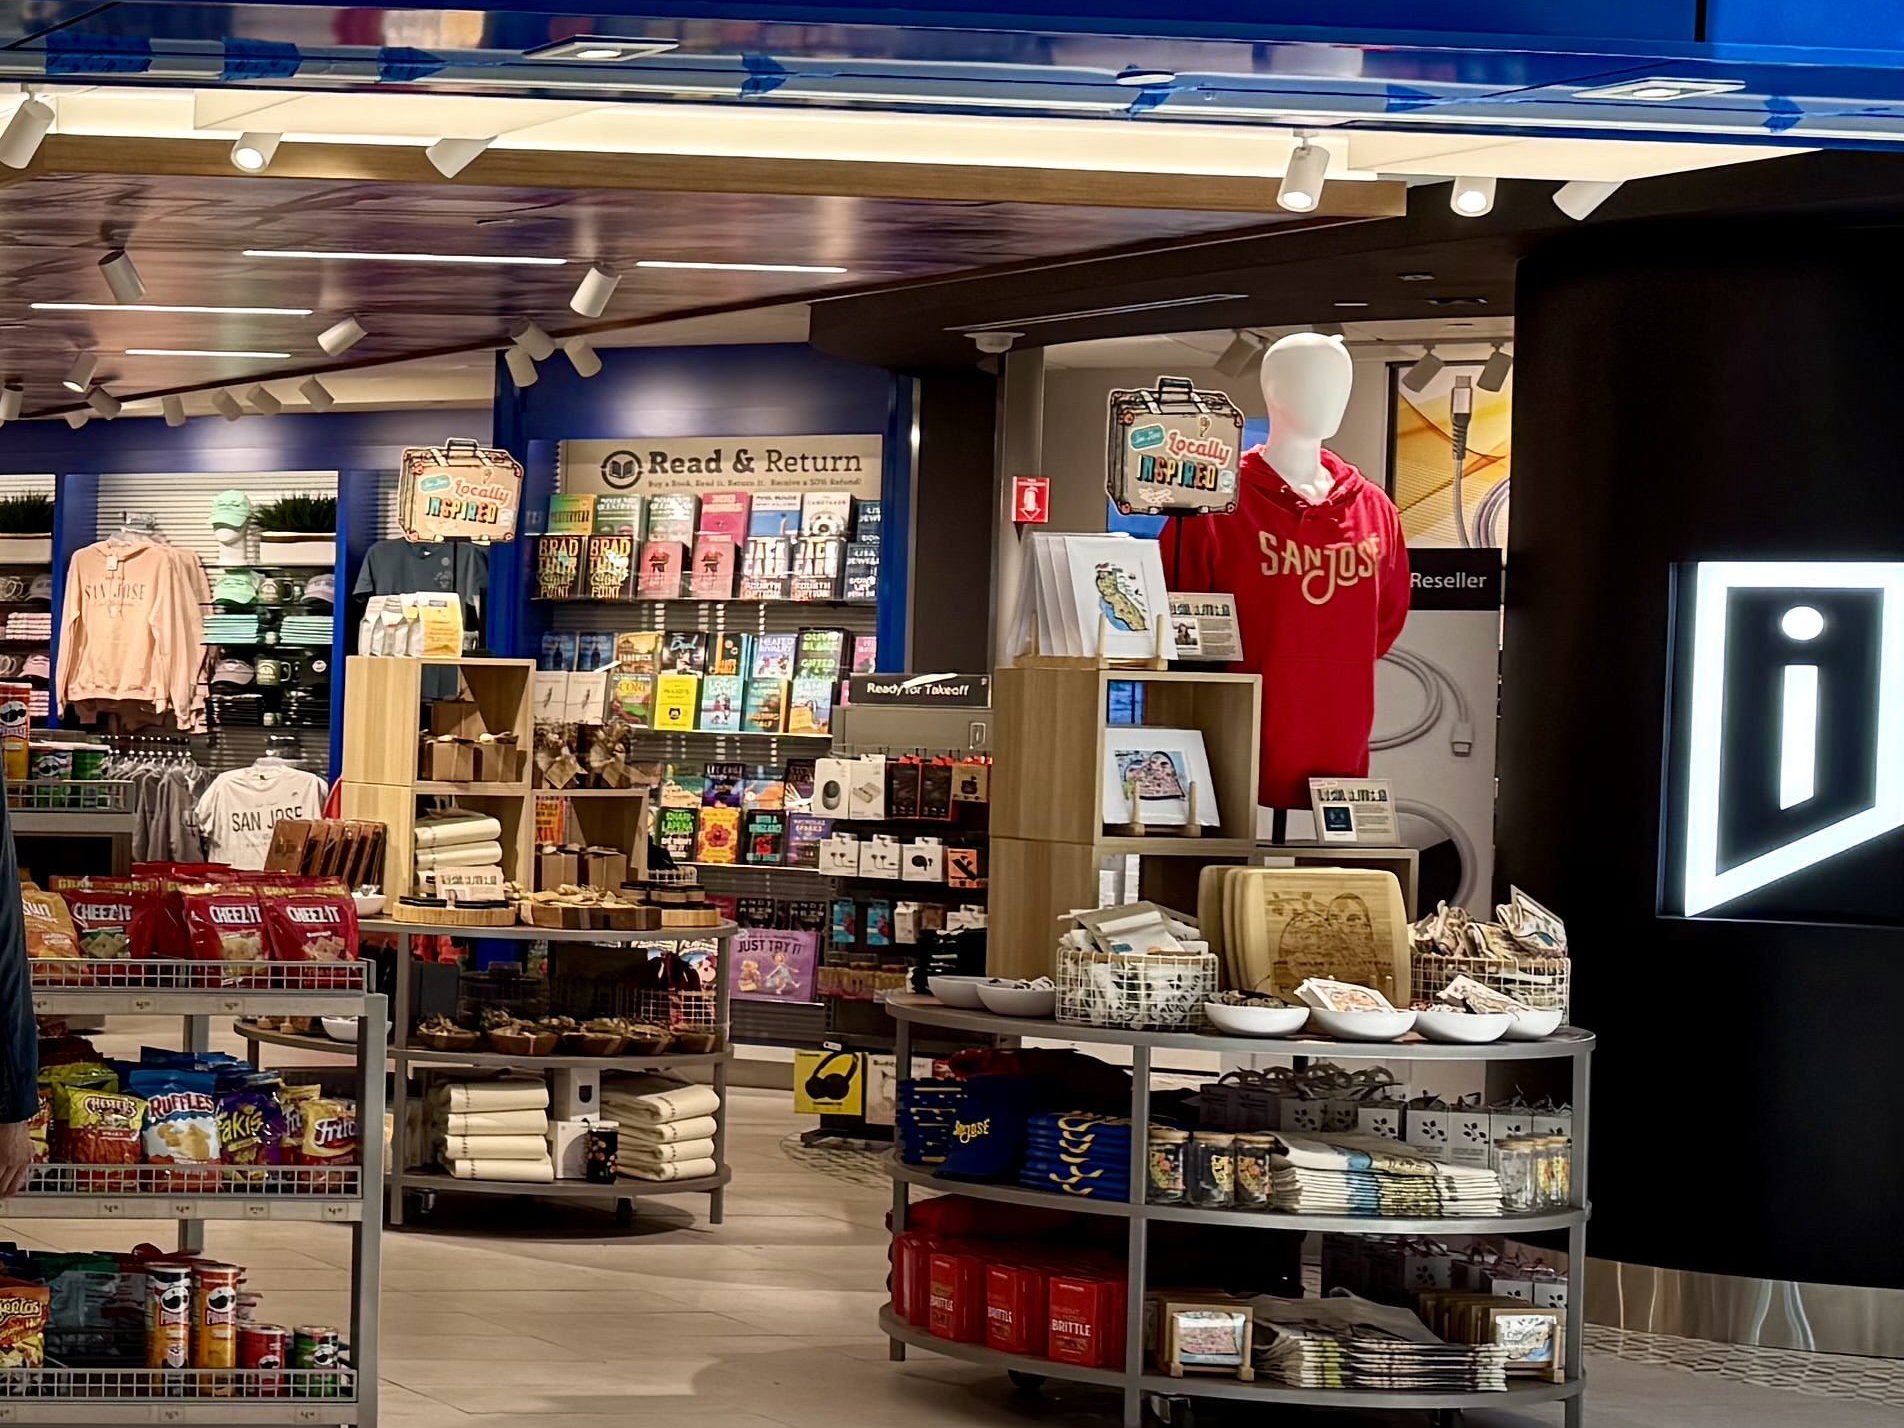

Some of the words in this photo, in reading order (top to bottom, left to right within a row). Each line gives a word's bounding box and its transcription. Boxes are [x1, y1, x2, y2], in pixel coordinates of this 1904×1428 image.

[1168, 431, 1230, 466] Locally
[649, 450, 723, 474] Read
[732, 448, 755, 473] &
[765, 448, 863, 474] Return
[1137, 454, 1219, 492] INSPIRED
[455, 479, 509, 503] Locally
[648, 481, 663, 489] Buy
[426, 496, 499, 525] INSPIRED
[540, 539, 579, 557] BRAD
[589, 538, 631, 557] BRAD
[1258, 529, 1323, 578] SAN
[1409, 571, 1488, 590] Reseller
[84, 585, 107, 601] SAN
[113, 584, 146, 601] JOSE
[866, 682, 902, 699] Ready
[924, 682, 969, 698] Takeoff
[232, 807, 264, 833] SAN
[738, 940, 766, 953] JUST
[768, 939, 790, 954] TRY
[149, 1092, 214, 1120] RUFFLES
[930, 1294, 954, 1313] BRITTLE
[987, 1305, 1013, 1324] BRITTLE
[1051, 1318, 1092, 1337] BRITTLE
